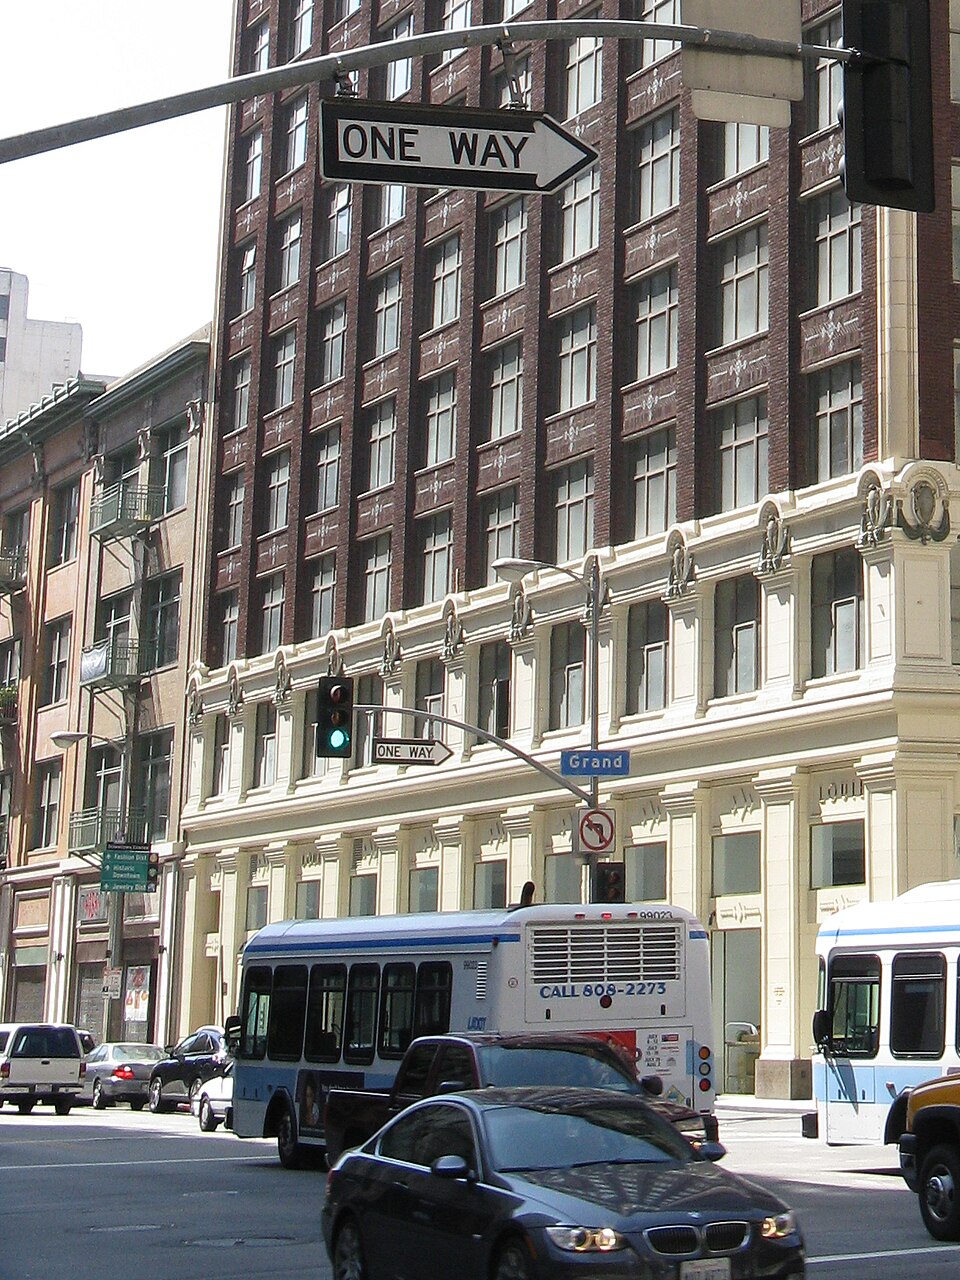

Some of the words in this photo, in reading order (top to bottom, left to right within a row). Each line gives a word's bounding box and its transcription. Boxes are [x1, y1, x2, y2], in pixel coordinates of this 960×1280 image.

[343, 124, 421, 162] ONE
[450, 132, 528, 168] WAY
[377, 744, 401, 758] ONE
[409, 746, 433, 759] WAY
[569, 754, 622, 769] Grand
[639, 911, 673, 919] 99023
[540, 985, 580, 998] CALL
[582, 982, 666, 997] 808-2273
